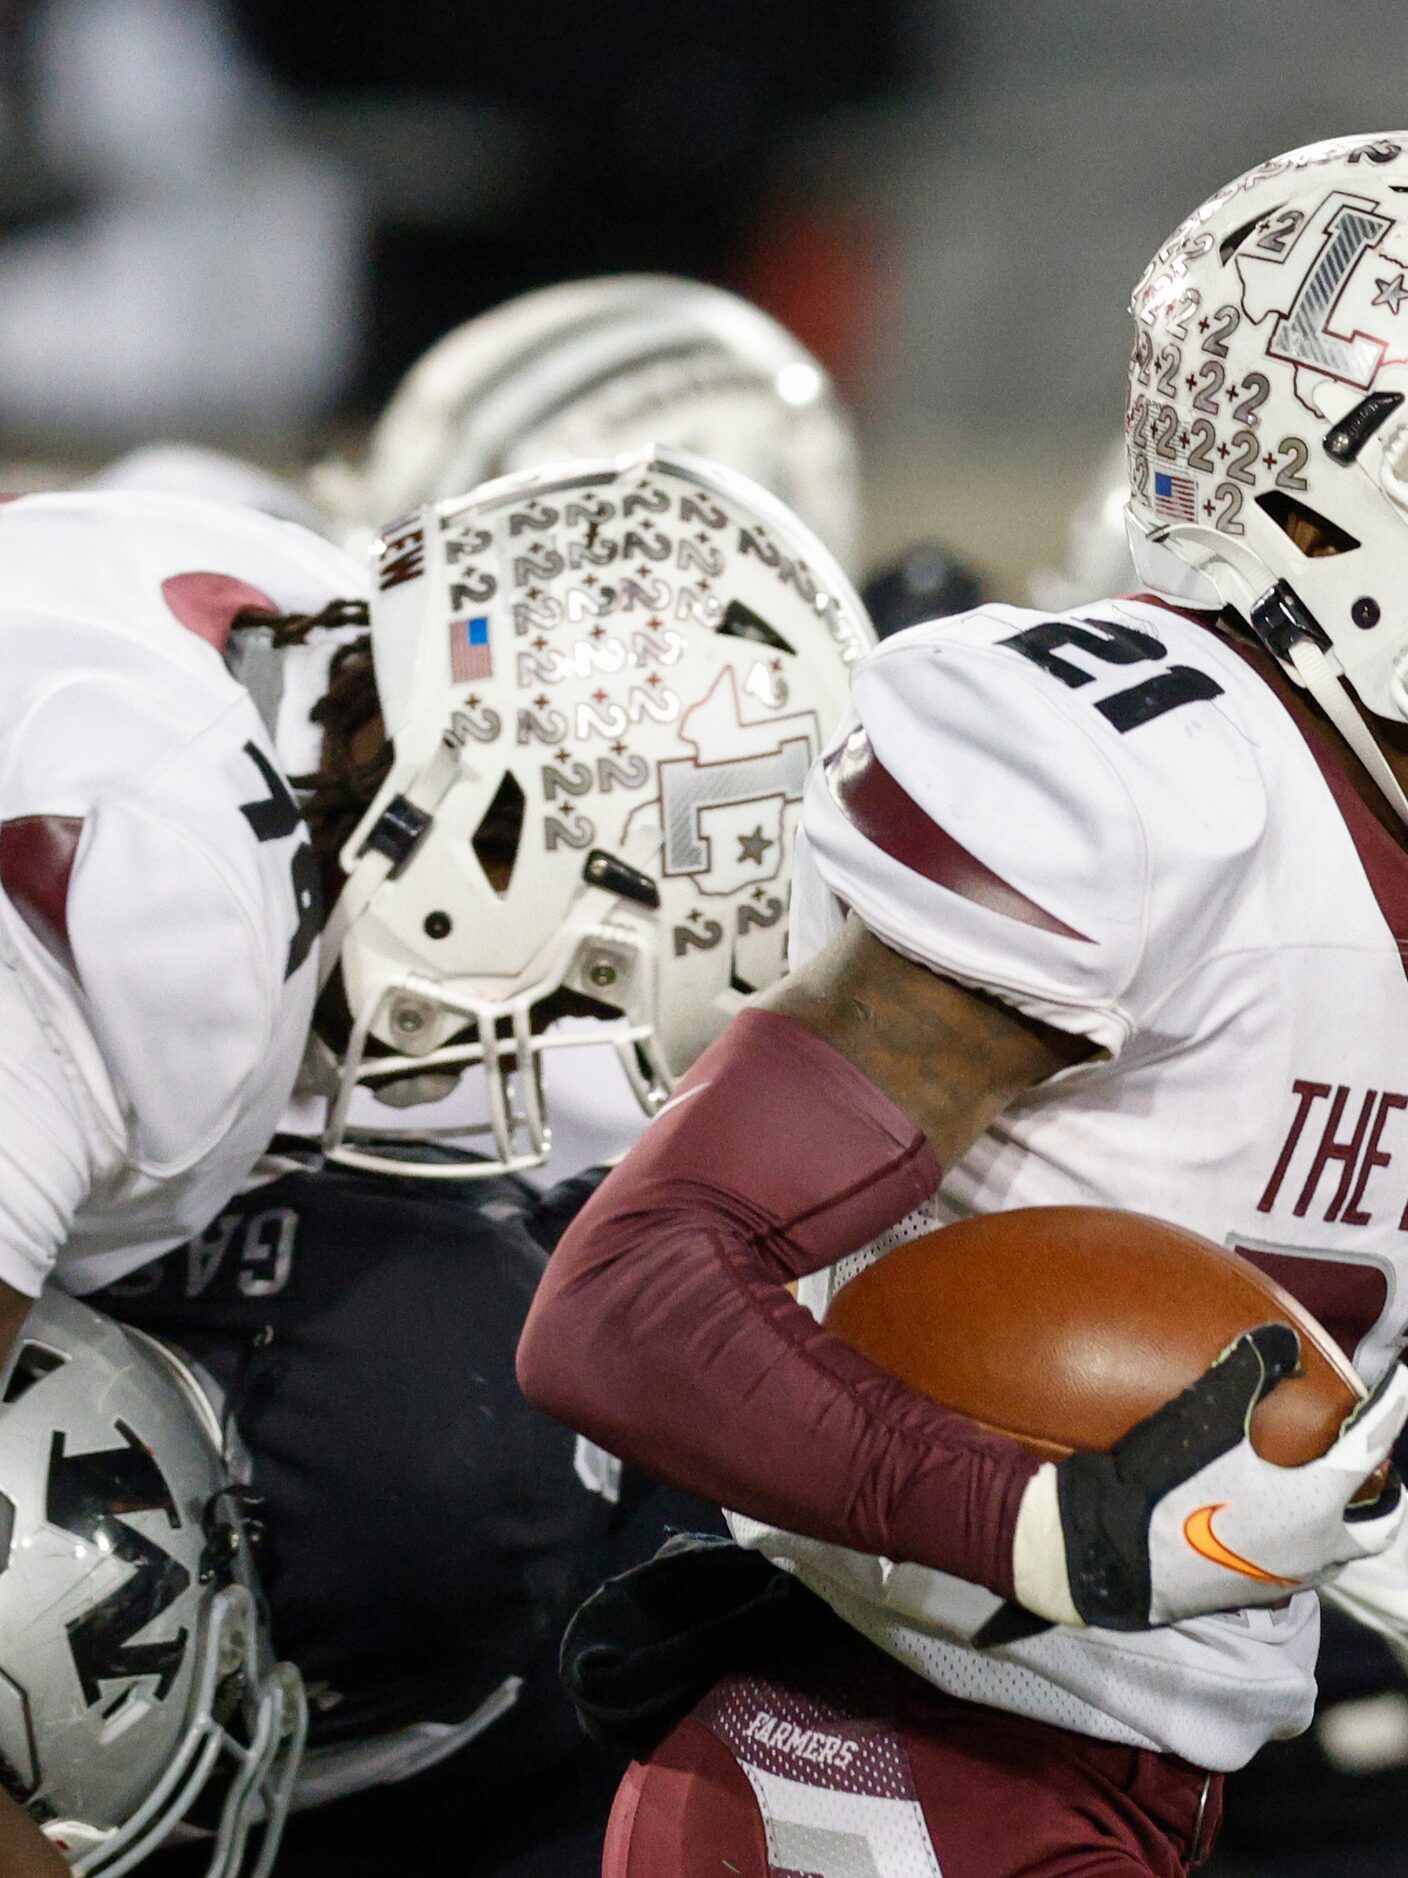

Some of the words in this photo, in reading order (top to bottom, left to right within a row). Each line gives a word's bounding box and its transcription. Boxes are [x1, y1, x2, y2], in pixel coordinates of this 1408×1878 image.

[991, 618, 1226, 734] 21
[1256, 1078, 1408, 1226] THE
[745, 1710, 860, 1768] FARMERS
